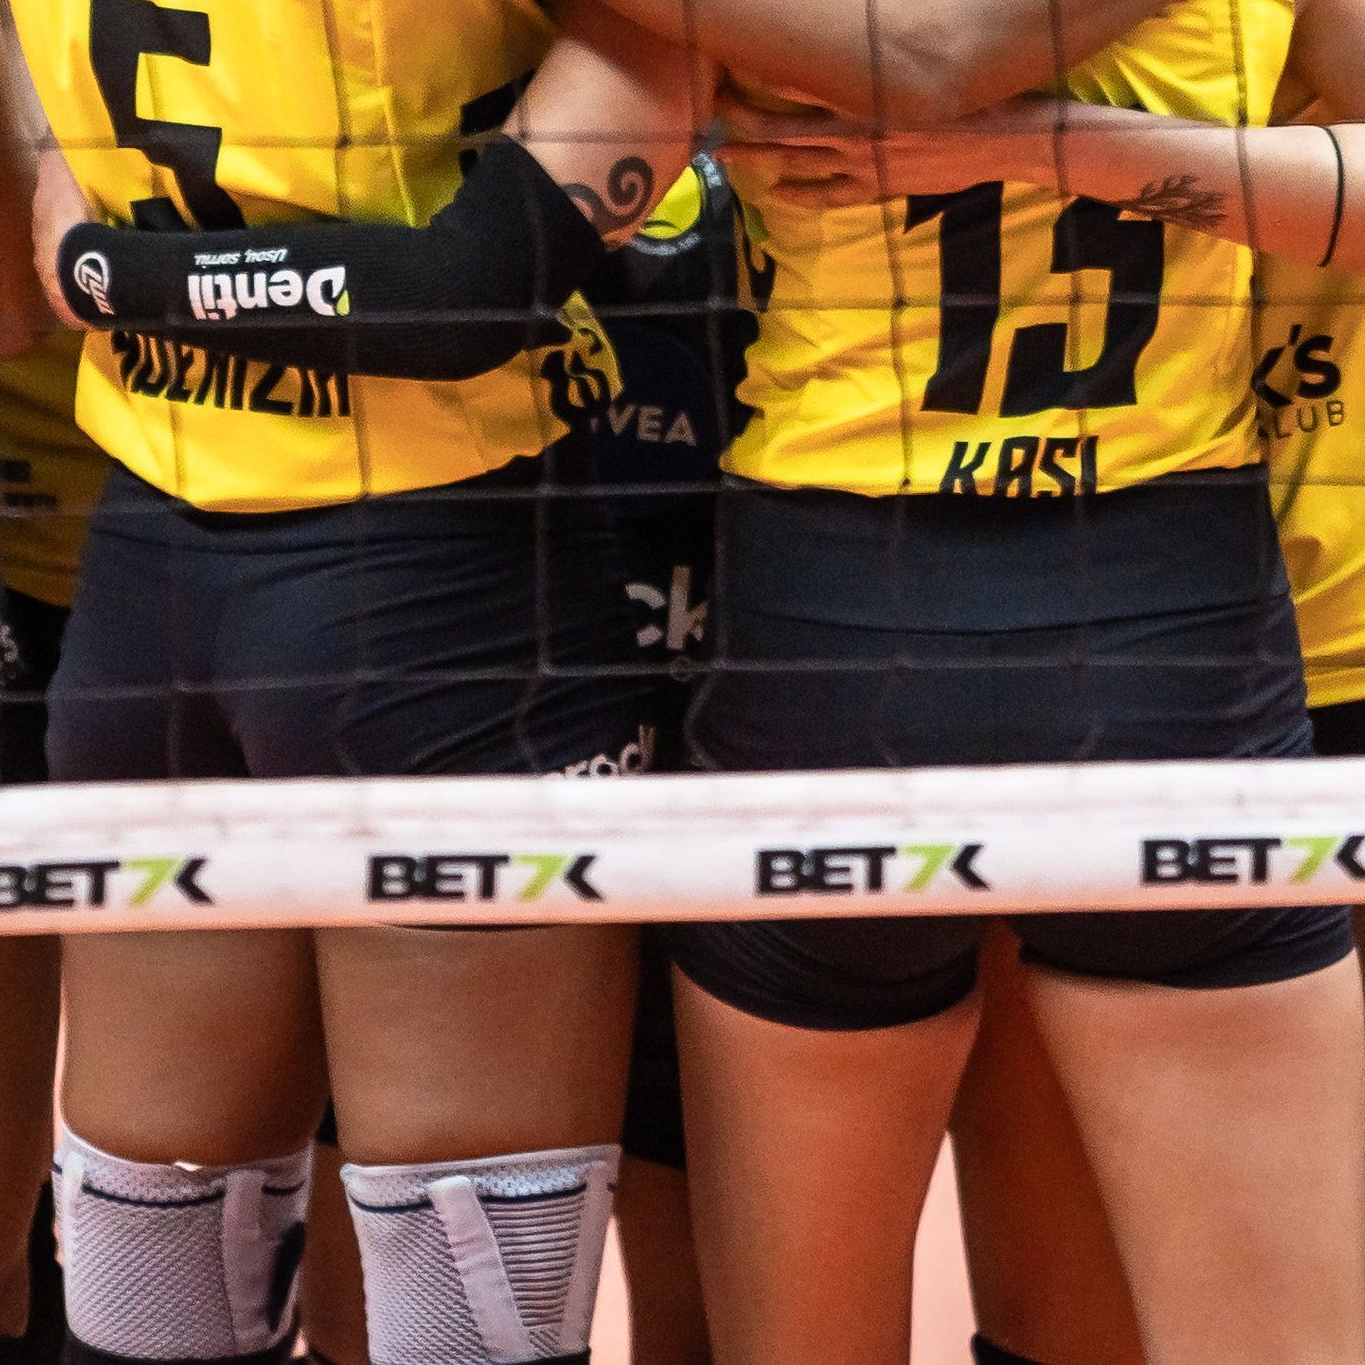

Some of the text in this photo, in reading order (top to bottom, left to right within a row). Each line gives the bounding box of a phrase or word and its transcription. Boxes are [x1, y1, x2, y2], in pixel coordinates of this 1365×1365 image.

[187, 265, 351, 322] Dentil
[366, 852, 602, 903] BET7K
[755, 841, 990, 897] BET7K
